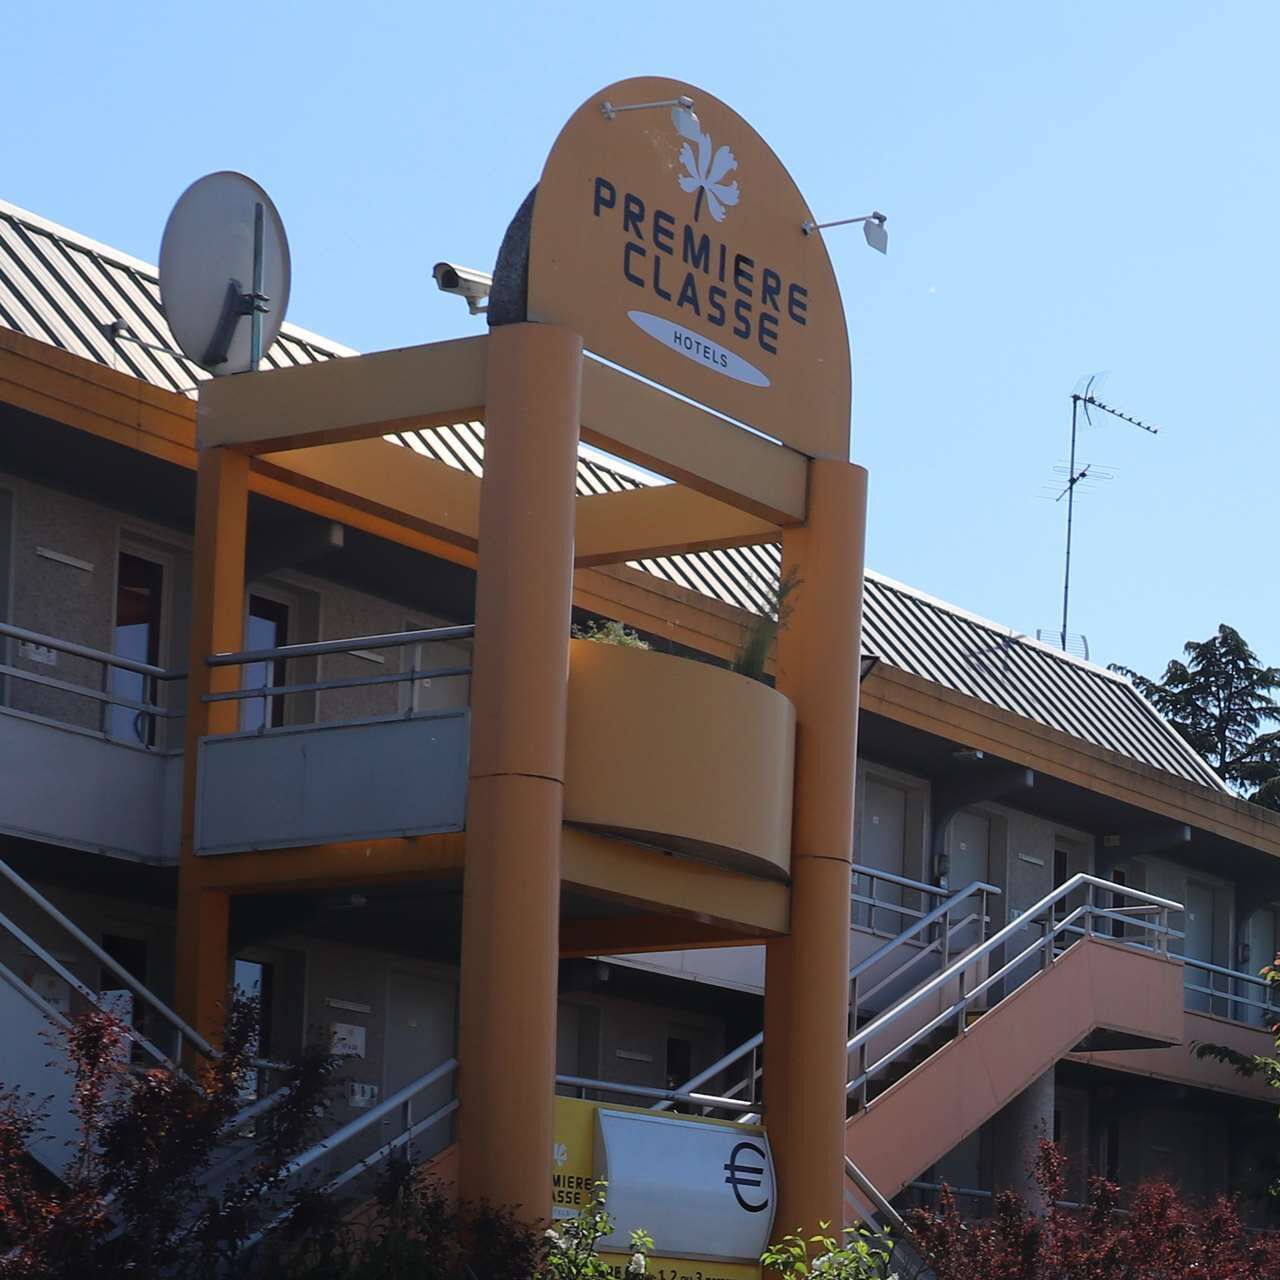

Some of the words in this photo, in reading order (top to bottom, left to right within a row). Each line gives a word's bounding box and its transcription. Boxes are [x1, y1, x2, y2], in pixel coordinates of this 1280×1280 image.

[593, 176, 808, 325] PREMIERE
[623, 241, 779, 355] CLASSE
[673, 330, 728, 368] HOTELS
[552, 1174, 592, 1190] MIERE
